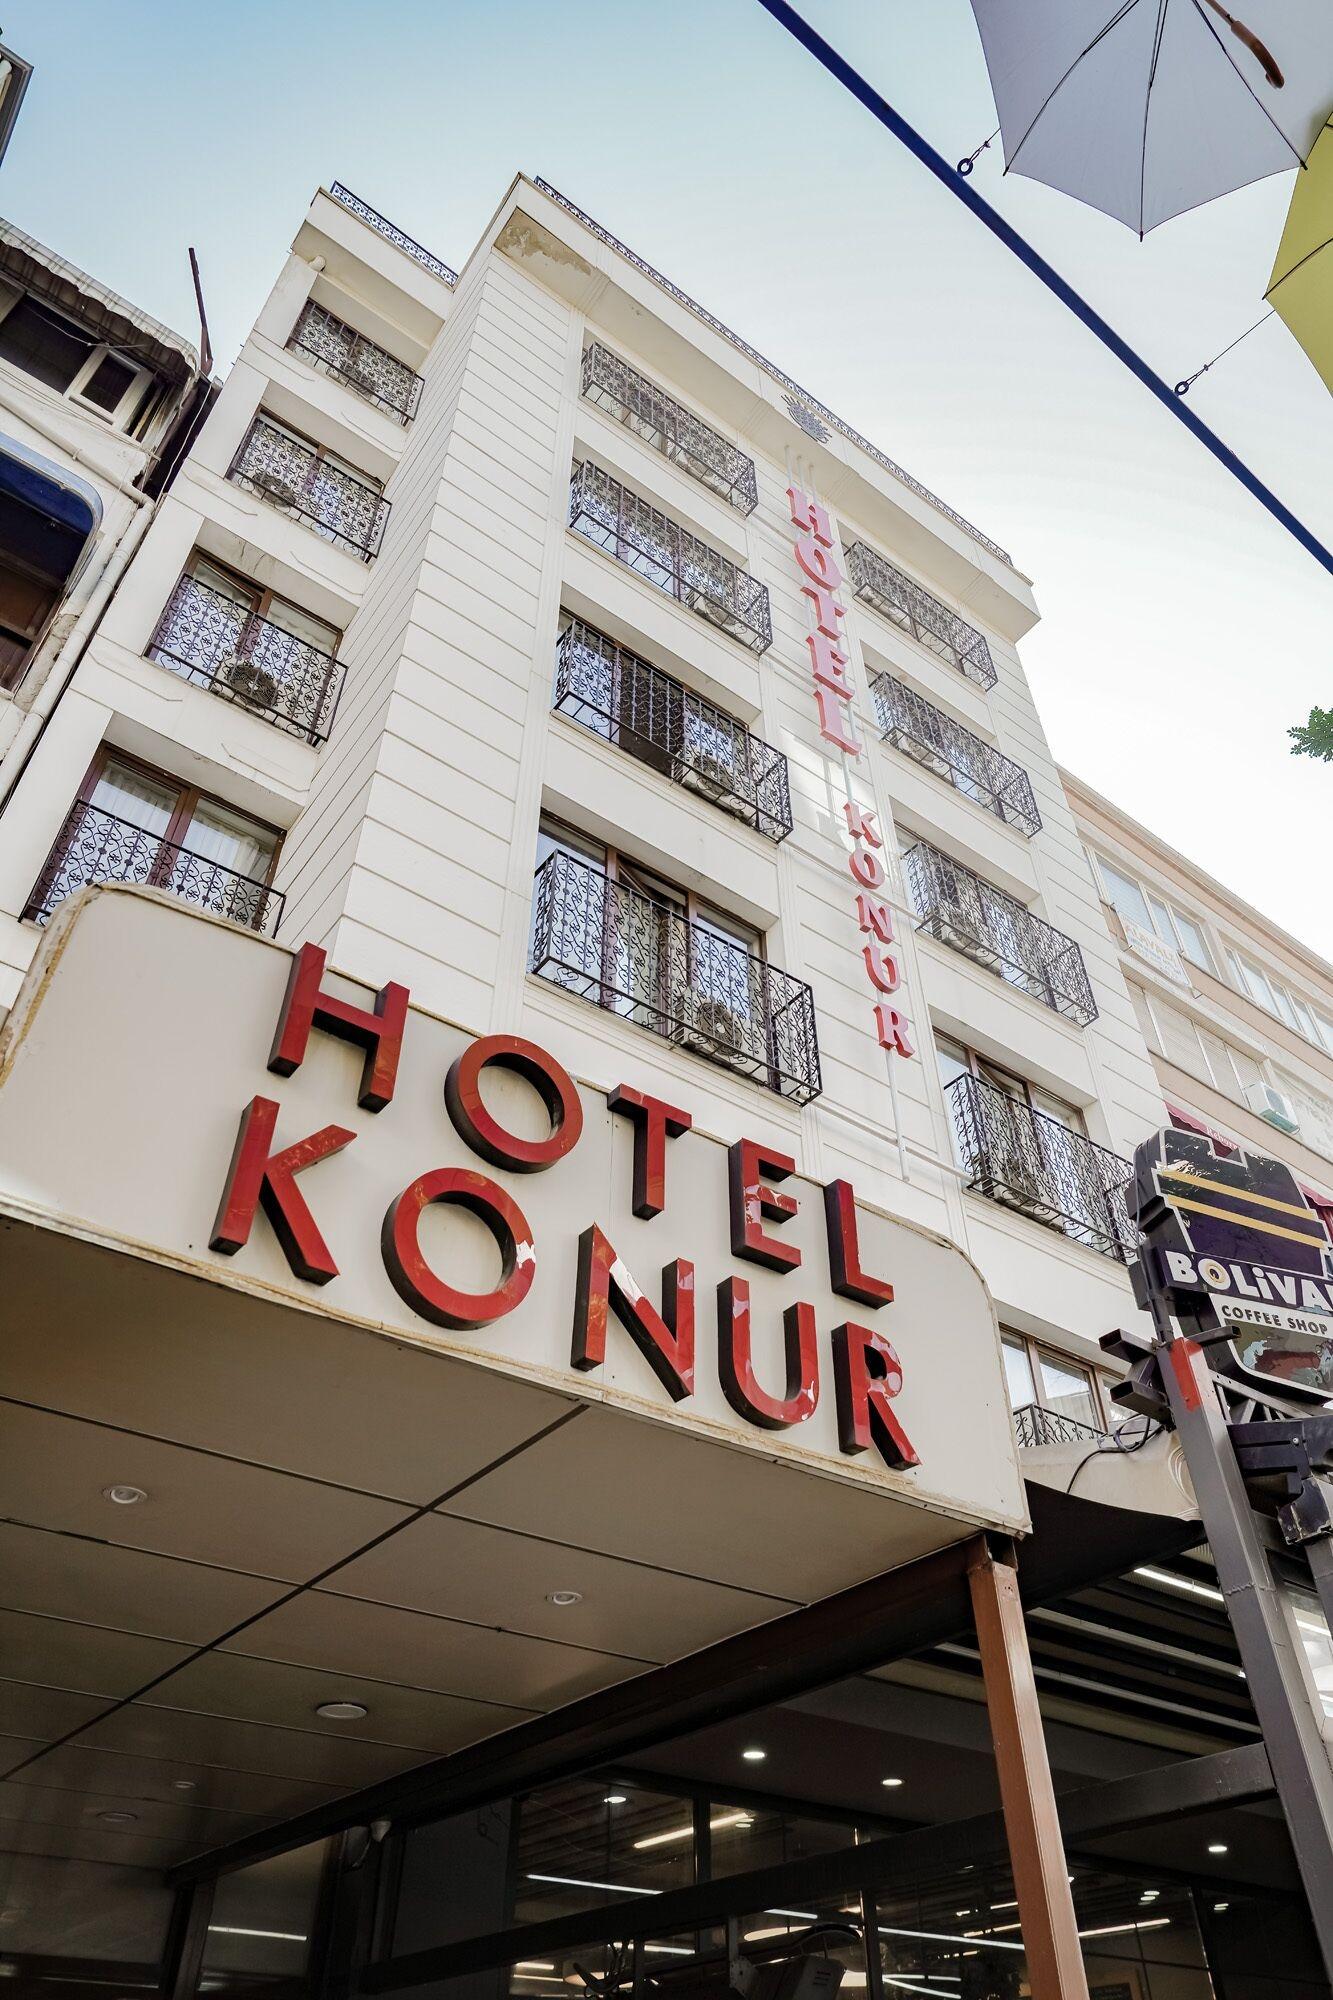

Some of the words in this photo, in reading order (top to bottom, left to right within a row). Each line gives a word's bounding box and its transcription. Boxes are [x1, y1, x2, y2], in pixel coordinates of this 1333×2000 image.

[786, 487, 862, 756] HOTEL
[843, 802, 915, 1059] KONUR
[208, 1095, 922, 1471] KONUR
[267, 942, 894, 1309] HOTEL
[1165, 1250, 1333, 1312] BOLiVA
[1221, 1304, 1282, 1327] COFFEE
[1288, 1317, 1328, 1335] SHOP
